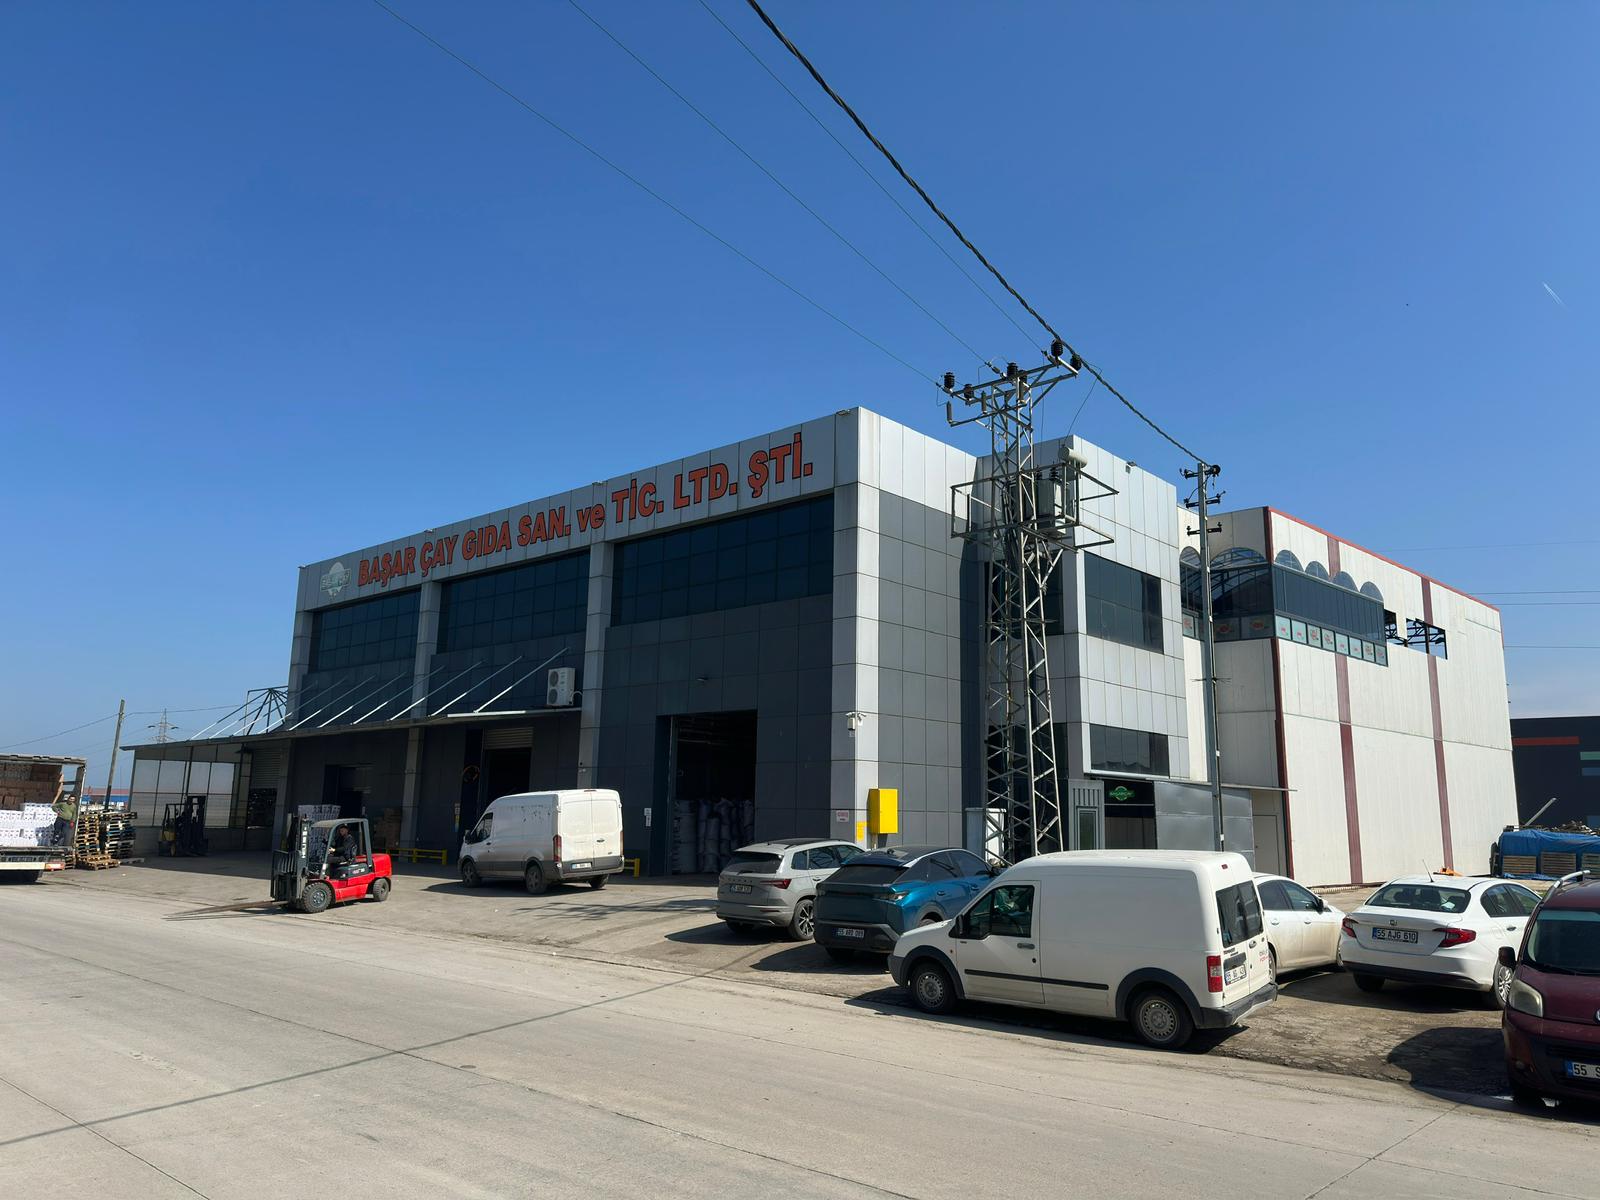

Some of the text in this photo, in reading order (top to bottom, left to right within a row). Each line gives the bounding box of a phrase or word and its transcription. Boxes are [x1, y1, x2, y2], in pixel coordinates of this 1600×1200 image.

[359, 547, 416, 587] BAŞAR
[420, 536, 458, 576] ÇAY
[461, 521, 512, 560] GIDA
[517, 507, 571, 546] SAN.
[577, 504, 605, 532] ve
[611, 478, 663, 524] TİC.
[673, 463, 737, 509] LTD.
[748, 433, 813, 498] ŞTİ.
[1377, 929, 1386, 938] 55
[1573, 1063, 1588, 1076] 55
